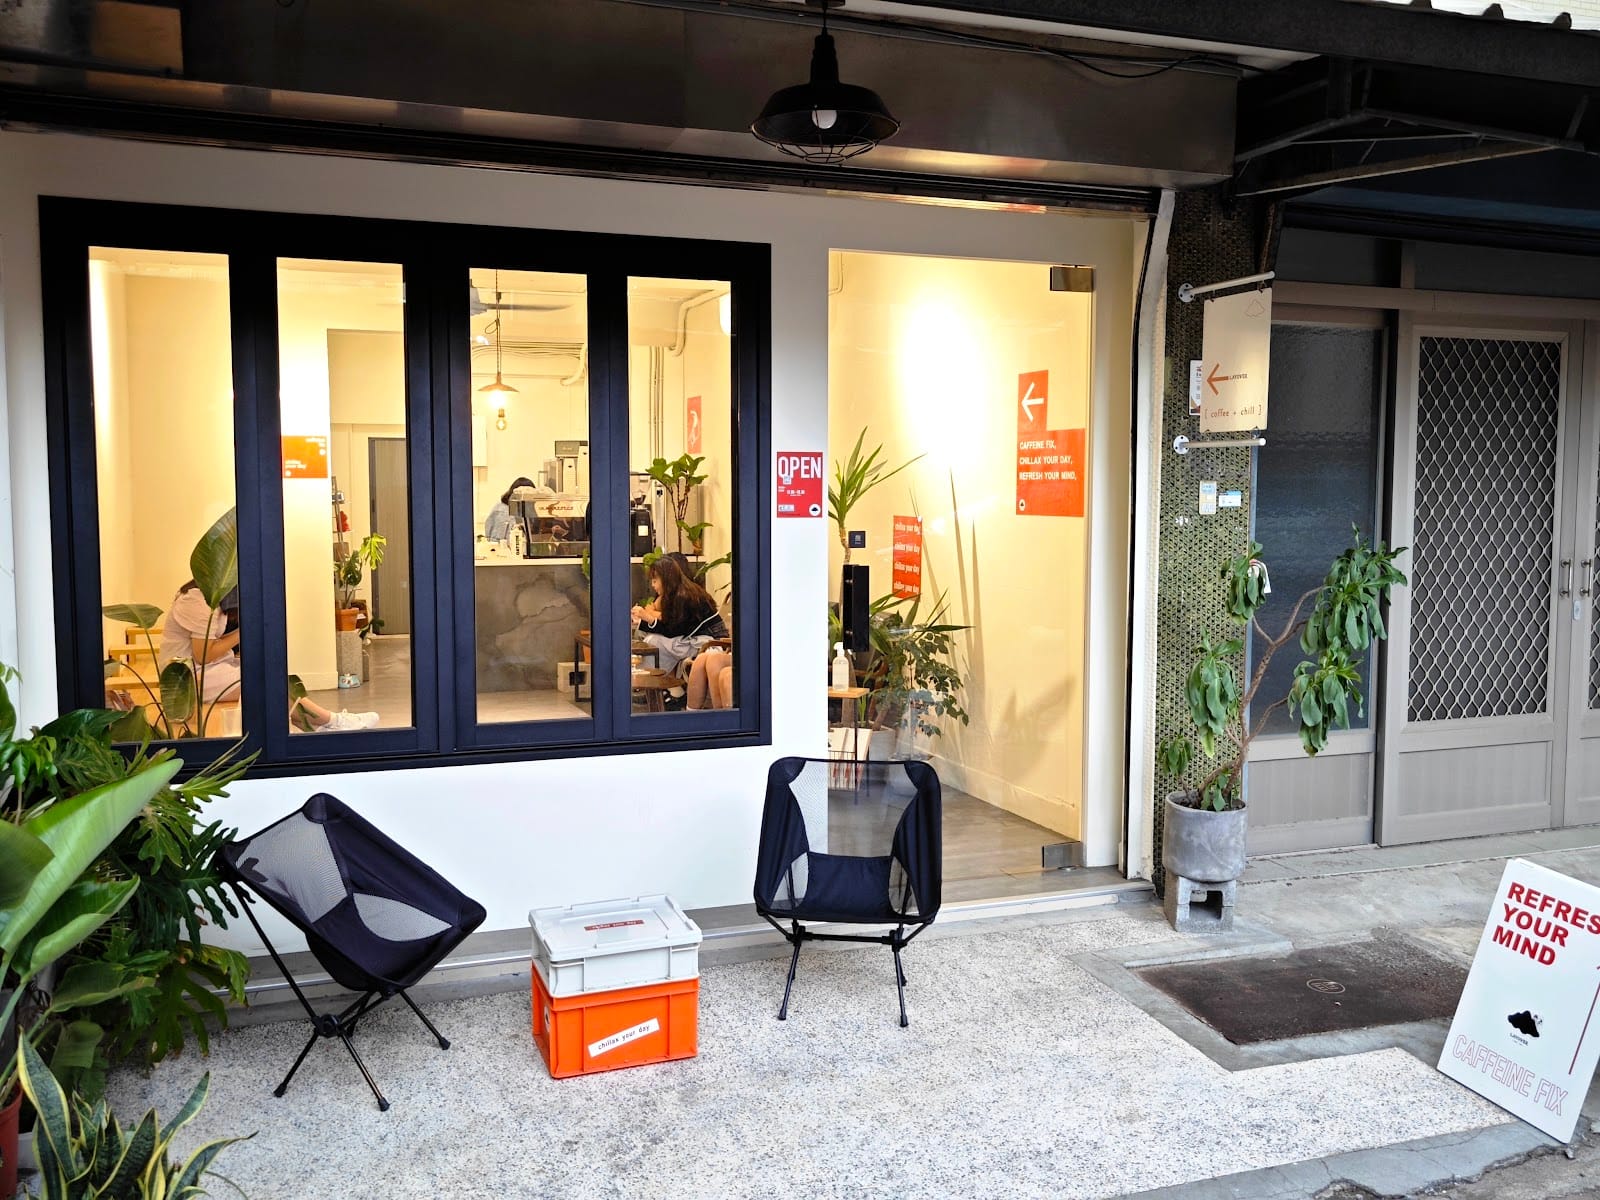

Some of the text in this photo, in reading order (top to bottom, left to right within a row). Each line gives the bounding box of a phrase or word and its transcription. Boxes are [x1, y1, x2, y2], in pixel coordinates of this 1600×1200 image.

[1210, 408, 1230, 418] coffee
[1240, 405, 1255, 416] chill
[1019, 441, 1045, 450] CAFFEINE
[778, 456, 822, 479] OPEN
[1019, 456, 1042, 465] CHILLAX
[1043, 456, 1059, 465] YOUR
[1019, 471, 1043, 481] REFRESH
[1044, 471, 1060, 481] YOUR
[1503, 902, 1569, 948] YOUR
[1491, 925, 1556, 966] MIND
[598, 1024, 650, 1050] chillax your day
[1452, 1034, 1569, 1117] CAFFEINE FIX
